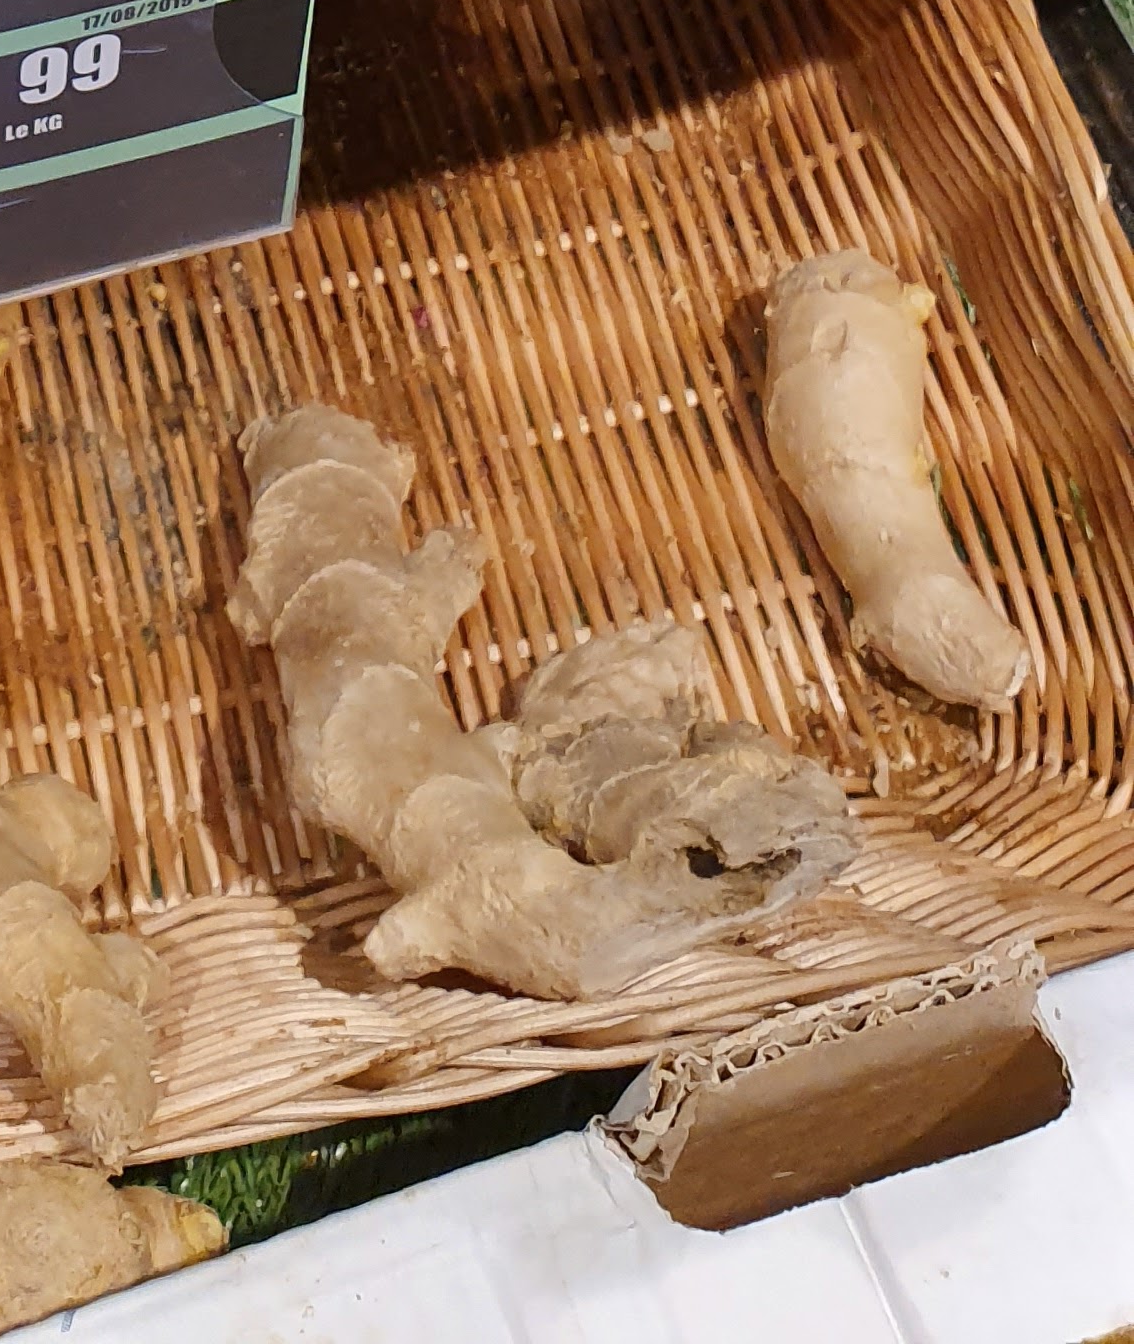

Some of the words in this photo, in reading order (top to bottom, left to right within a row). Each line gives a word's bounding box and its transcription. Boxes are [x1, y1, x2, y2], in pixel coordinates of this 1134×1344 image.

[18, 33, 122, 105] 99
[4, 123, 29, 143] Le
[33, 113, 64, 136] KG
